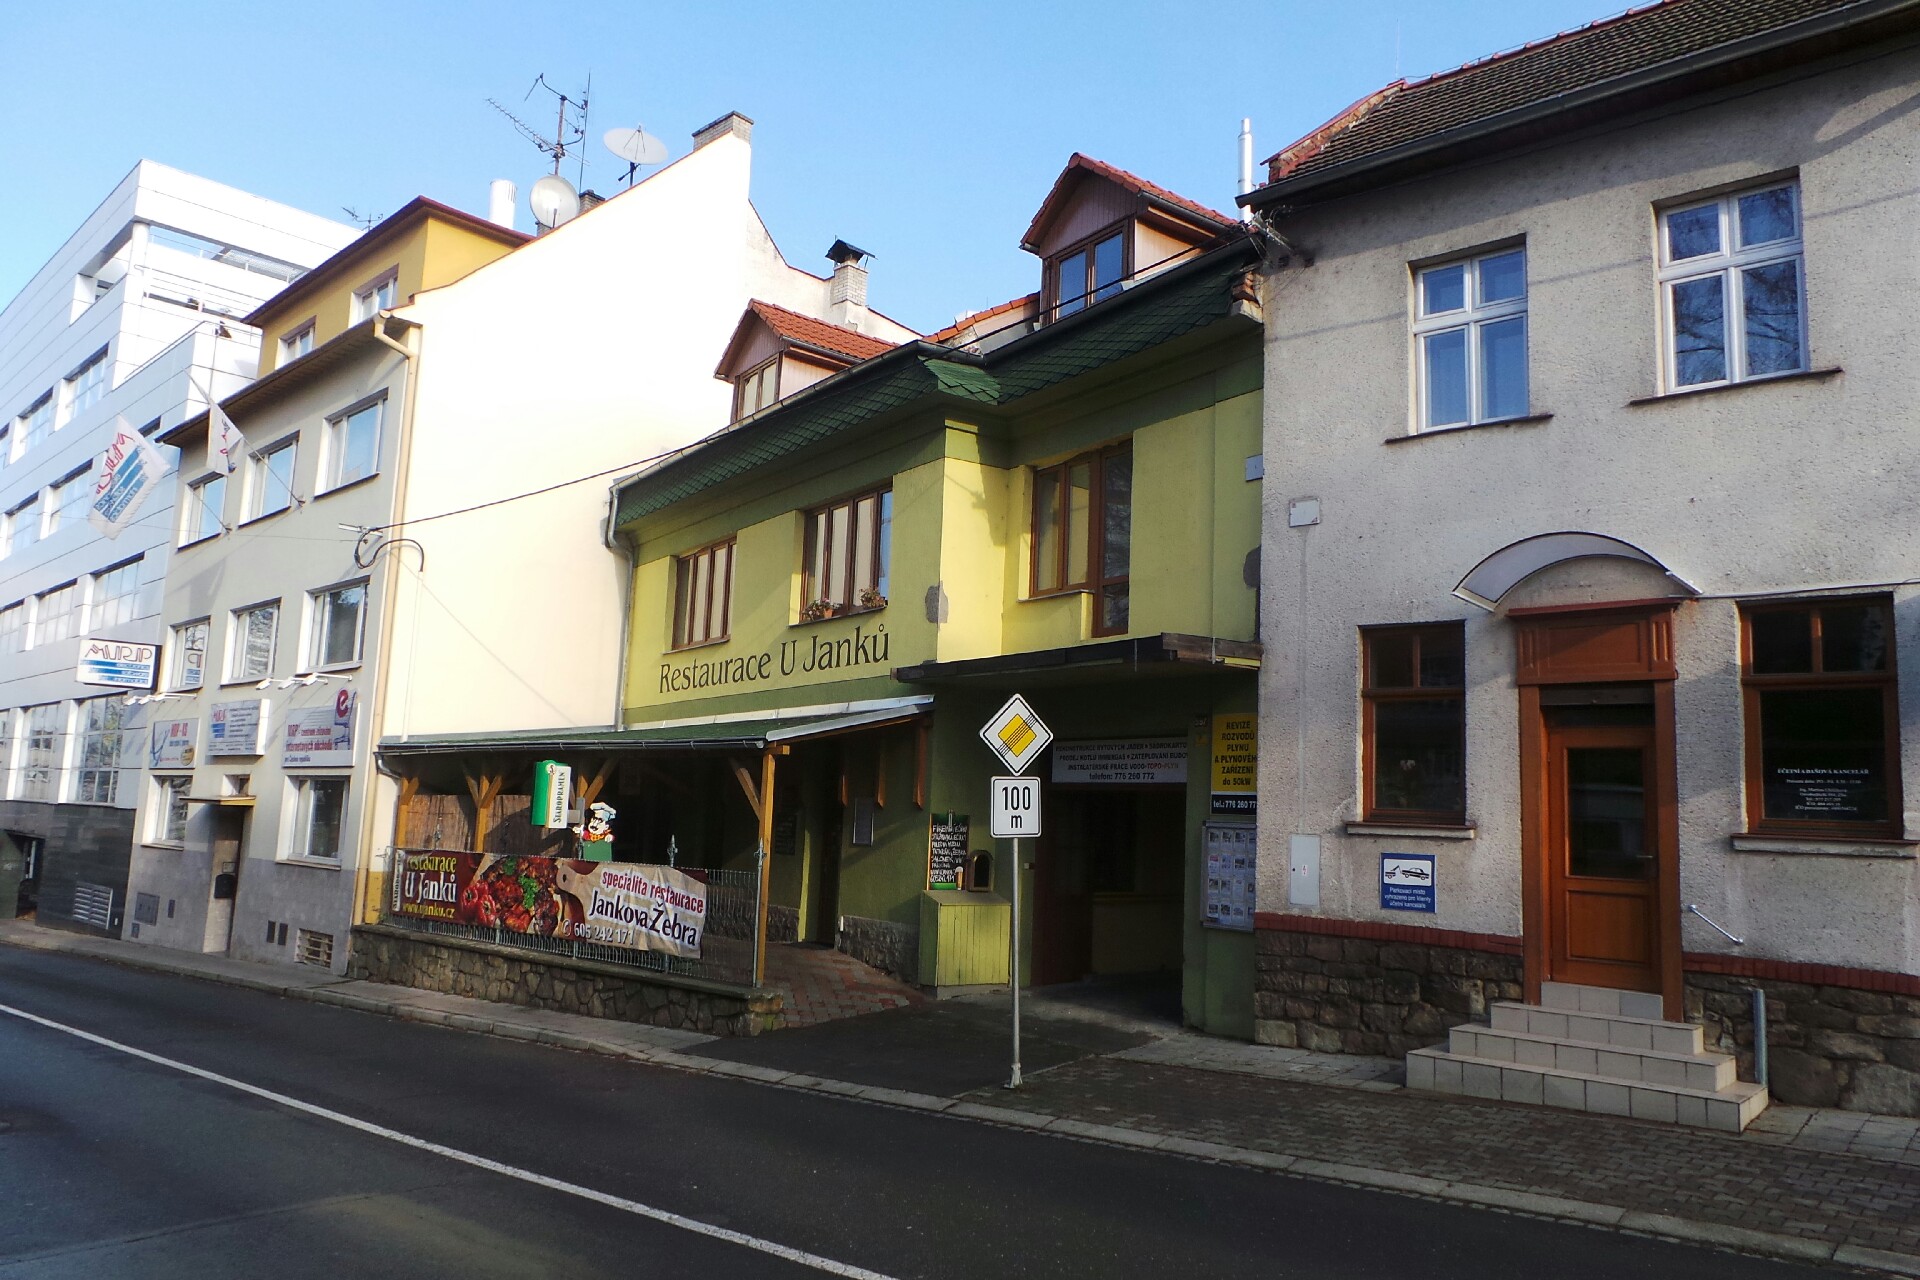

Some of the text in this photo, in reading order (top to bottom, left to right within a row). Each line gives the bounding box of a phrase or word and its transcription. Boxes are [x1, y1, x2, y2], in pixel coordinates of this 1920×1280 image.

[659, 623, 889, 694] Restaurace U Janků
[1226, 721, 1250, 730] REVIZE
[1226, 744, 1249, 752] PLYNU
[1214, 755, 1219, 763] A
[1089, 772, 1113, 780] telefon:
[1114, 772, 1127, 780] 776
[1142, 772, 1155, 780] 772
[1222, 777, 1231, 786] do
[1002, 786, 1031, 811] 100
[1011, 815, 1023, 828] m
[407, 853, 457, 873] restaurace
[405, 871, 457, 904] U Janků
[602, 871, 704, 914] specialita restaurace
[589, 890, 697, 946] Jankova Žebra
[574, 922, 635, 945] 605 242 171
